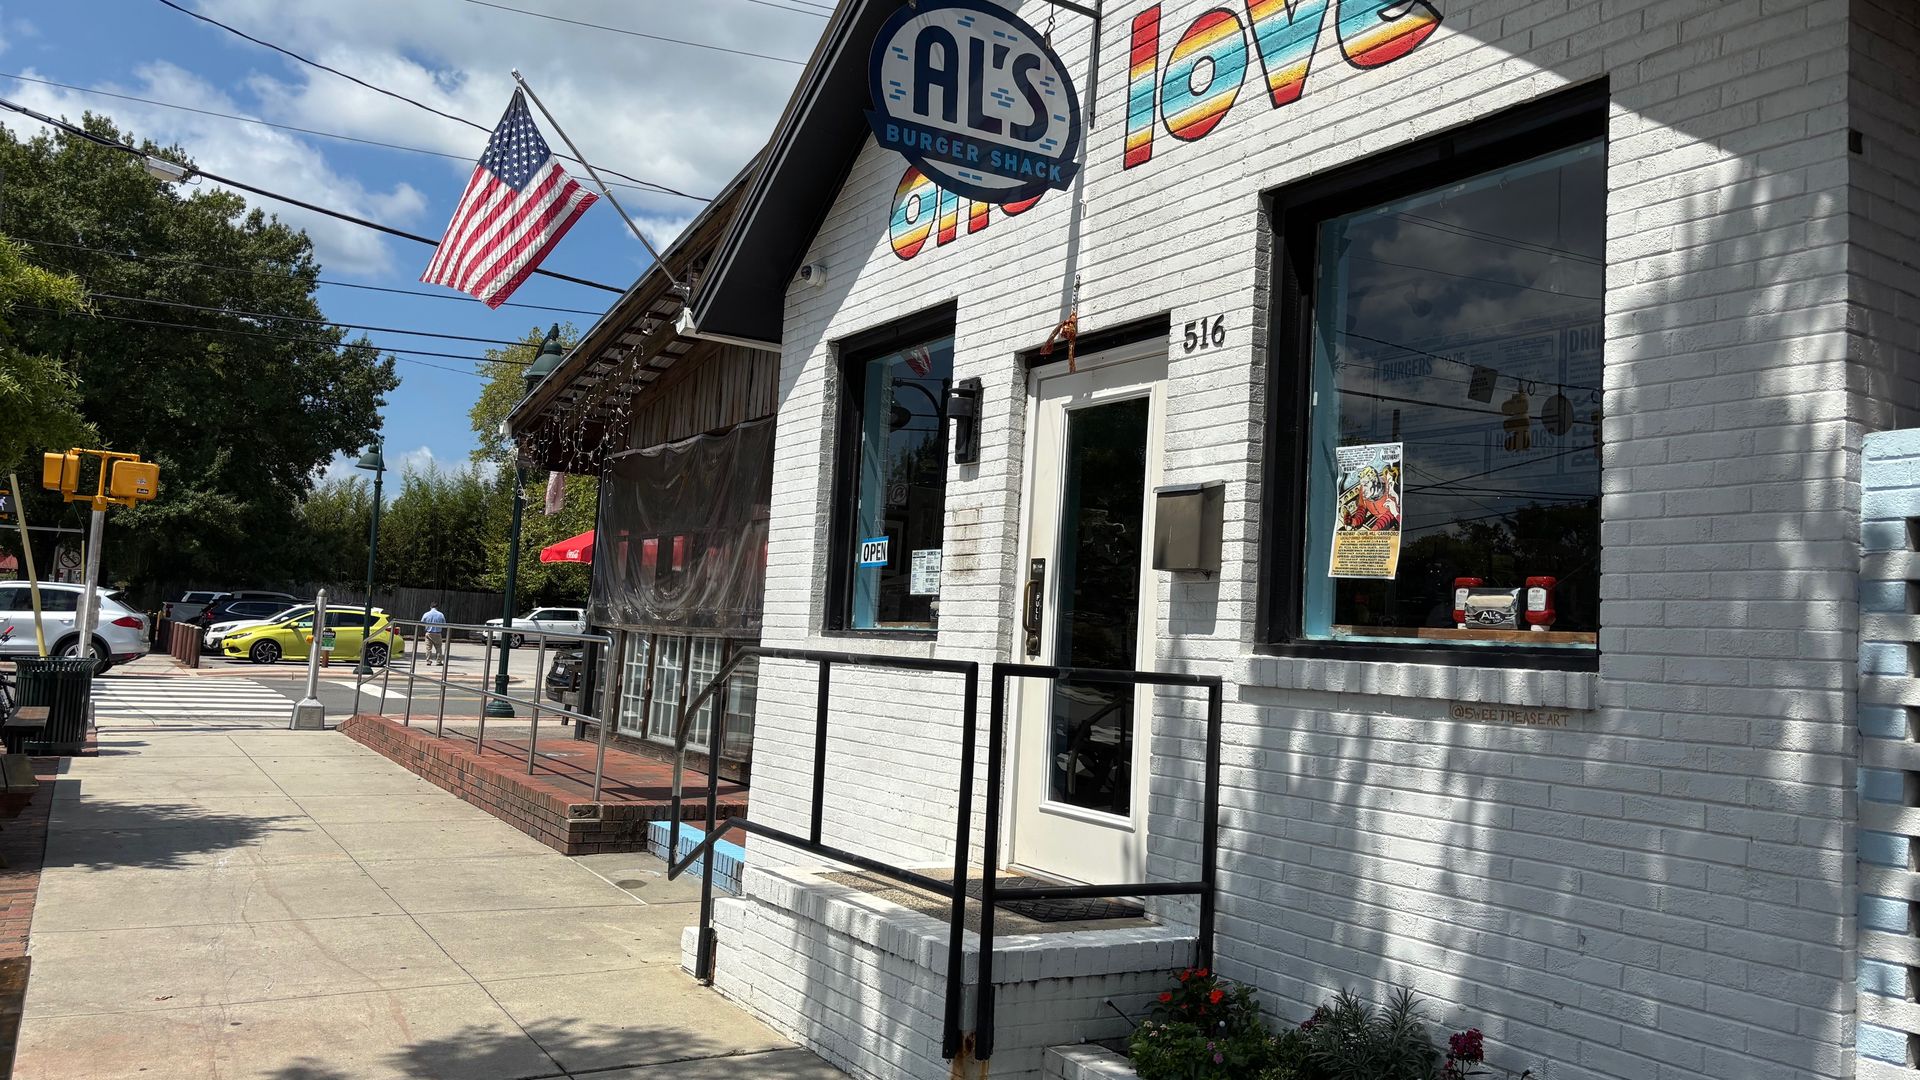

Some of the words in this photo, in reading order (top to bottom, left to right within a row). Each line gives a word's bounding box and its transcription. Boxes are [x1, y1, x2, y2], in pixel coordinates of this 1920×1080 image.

[913, 25, 1049, 142] AL'S
[886, 124, 979, 162] BURGER
[990, 150, 1062, 182] SHACK
[1183, 314, 1226, 353] 516
[1569, 325, 1600, 352] DRI
[1383, 357, 1433, 382] BURGERS
[863, 542, 887, 562] OPEN
